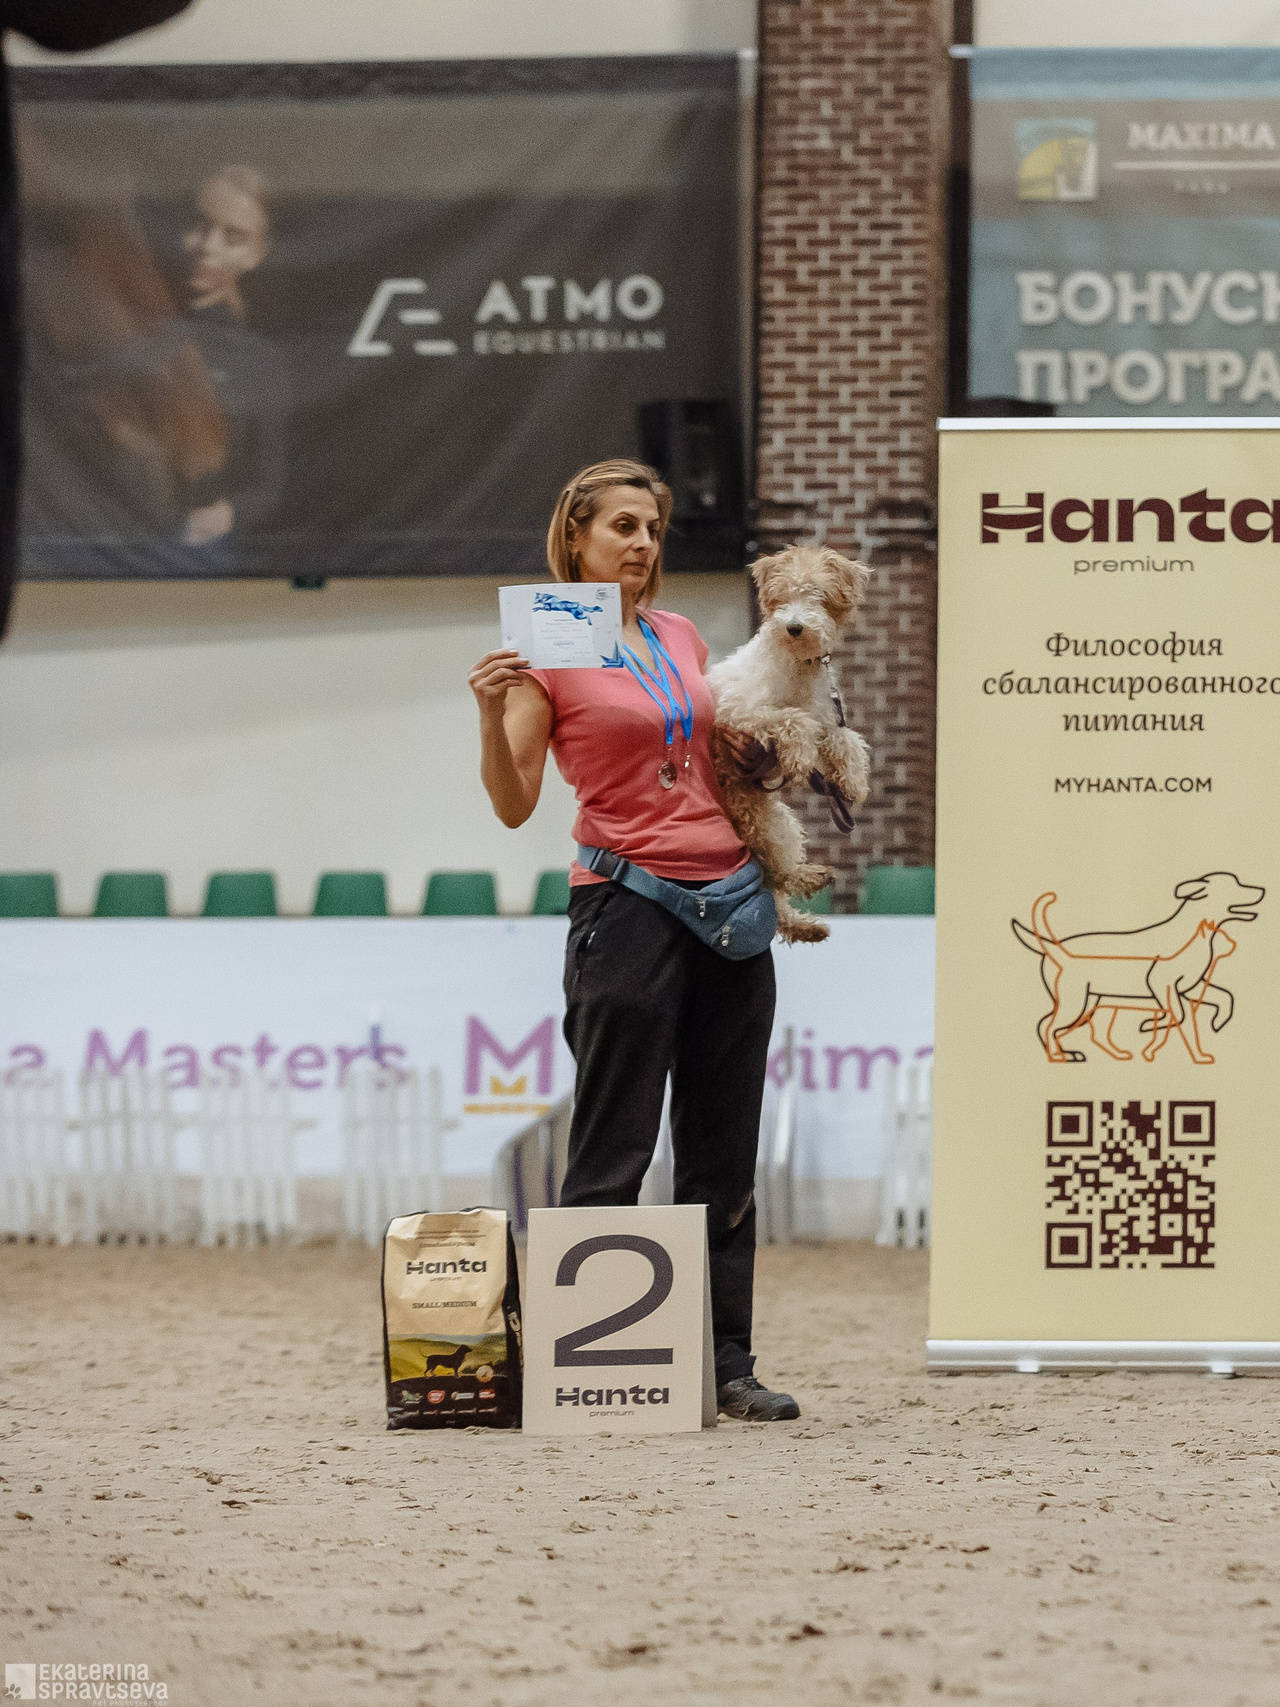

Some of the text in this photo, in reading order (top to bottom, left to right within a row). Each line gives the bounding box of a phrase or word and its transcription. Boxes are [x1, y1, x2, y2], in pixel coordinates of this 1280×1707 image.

[1127, 121, 1277, 150] MAXIMA
[474, 273, 665, 324] ATMO
[1073, 555, 1195, 576] premium
[1045, 630, 1223, 664] Философия
[1062, 711, 1206, 733] питания
[1053, 776, 1213, 794] MYHANTA.COM
[406, 1258, 487, 1275] Hanta
[553, 1233, 674, 1368] 2
[555, 1384, 670, 1408] Hanta
[588, 1408, 635, 1418] premium
